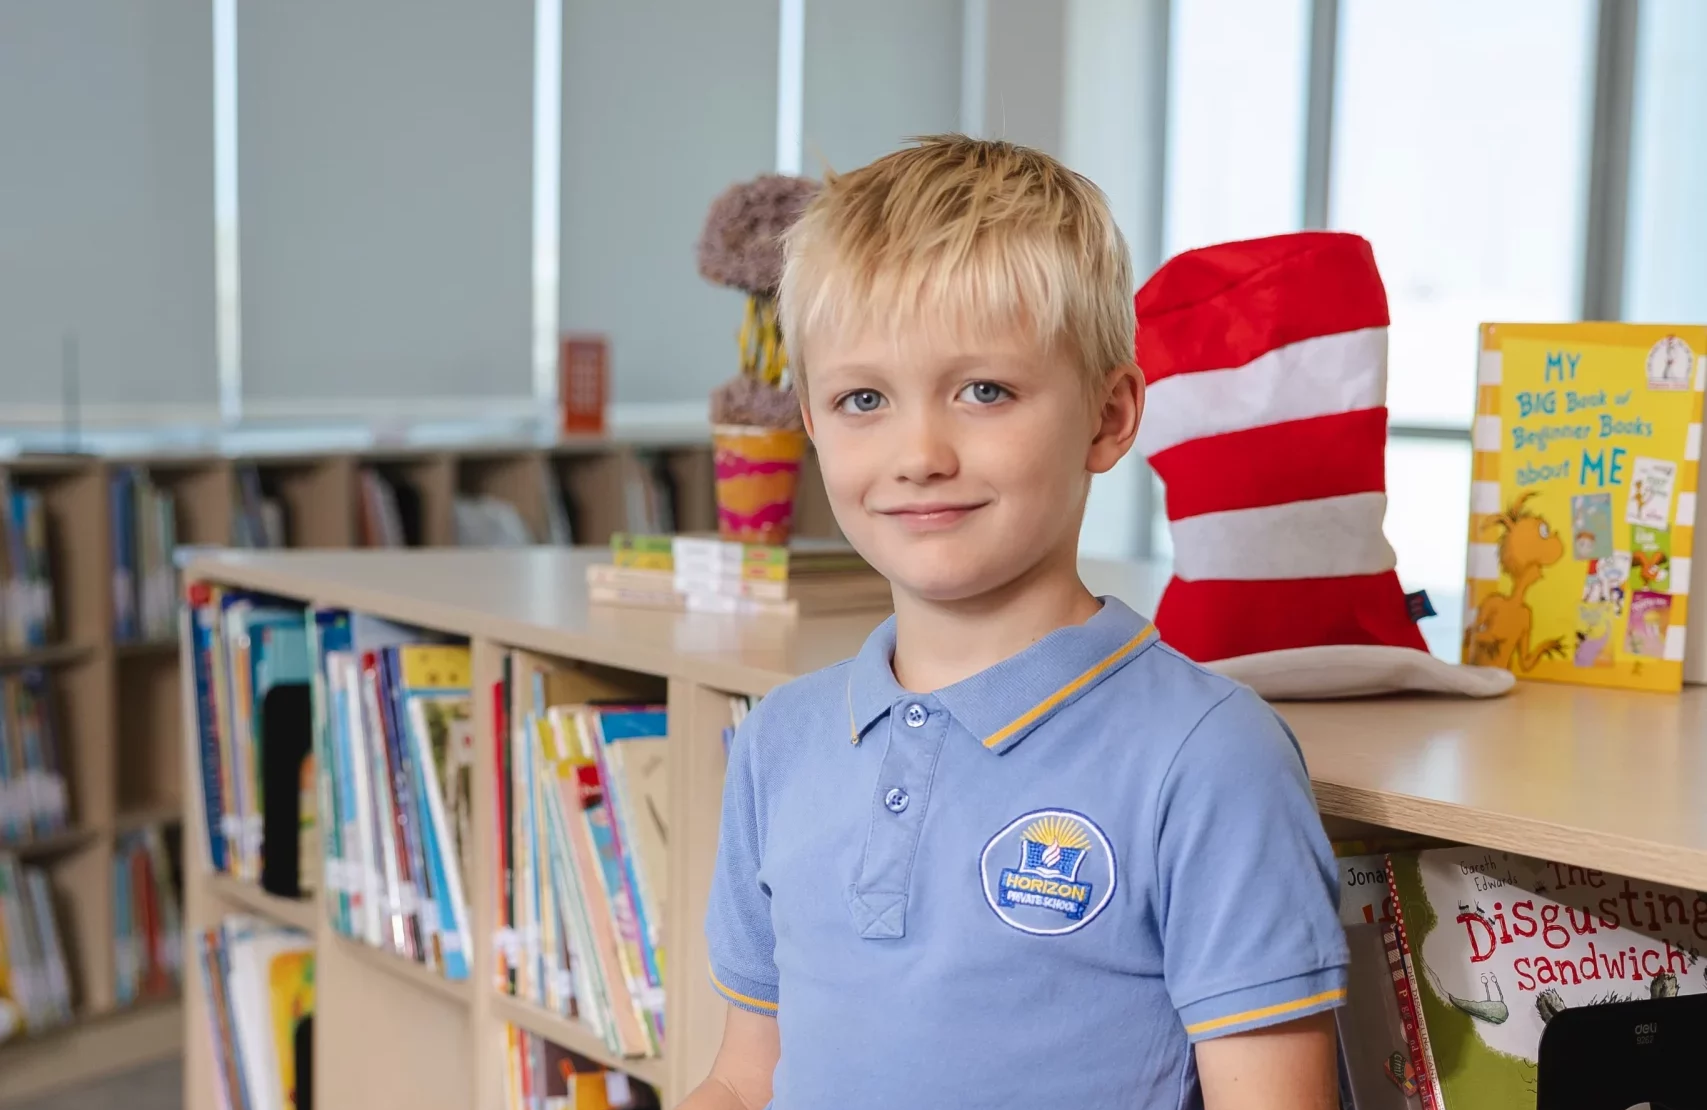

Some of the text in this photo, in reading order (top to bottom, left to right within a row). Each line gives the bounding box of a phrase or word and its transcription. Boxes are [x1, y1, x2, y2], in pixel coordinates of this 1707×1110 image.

[1544, 352, 1582, 383] MY
[1516, 391, 1557, 418] BIG
[1566, 391, 1607, 413] Book
[1512, 415, 1652, 451] Beginner Books
[1516, 448, 1627, 487] about ME
[1460, 855, 1498, 875] Gareth
[1547, 861, 1605, 890] The
[1006, 873, 1086, 901] HORIZON
[1475, 872, 1518, 892] Edwards
[1007, 890, 1078, 913] PRIVATE SCHOOL
[1457, 881, 1707, 962] Disgusting
[1406, 964, 1417, 986] THE
[1514, 942, 1688, 991] sandwich
[1411, 988, 1431, 1051] DISGUSTING
[1634, 1022, 1657, 1035] deli
